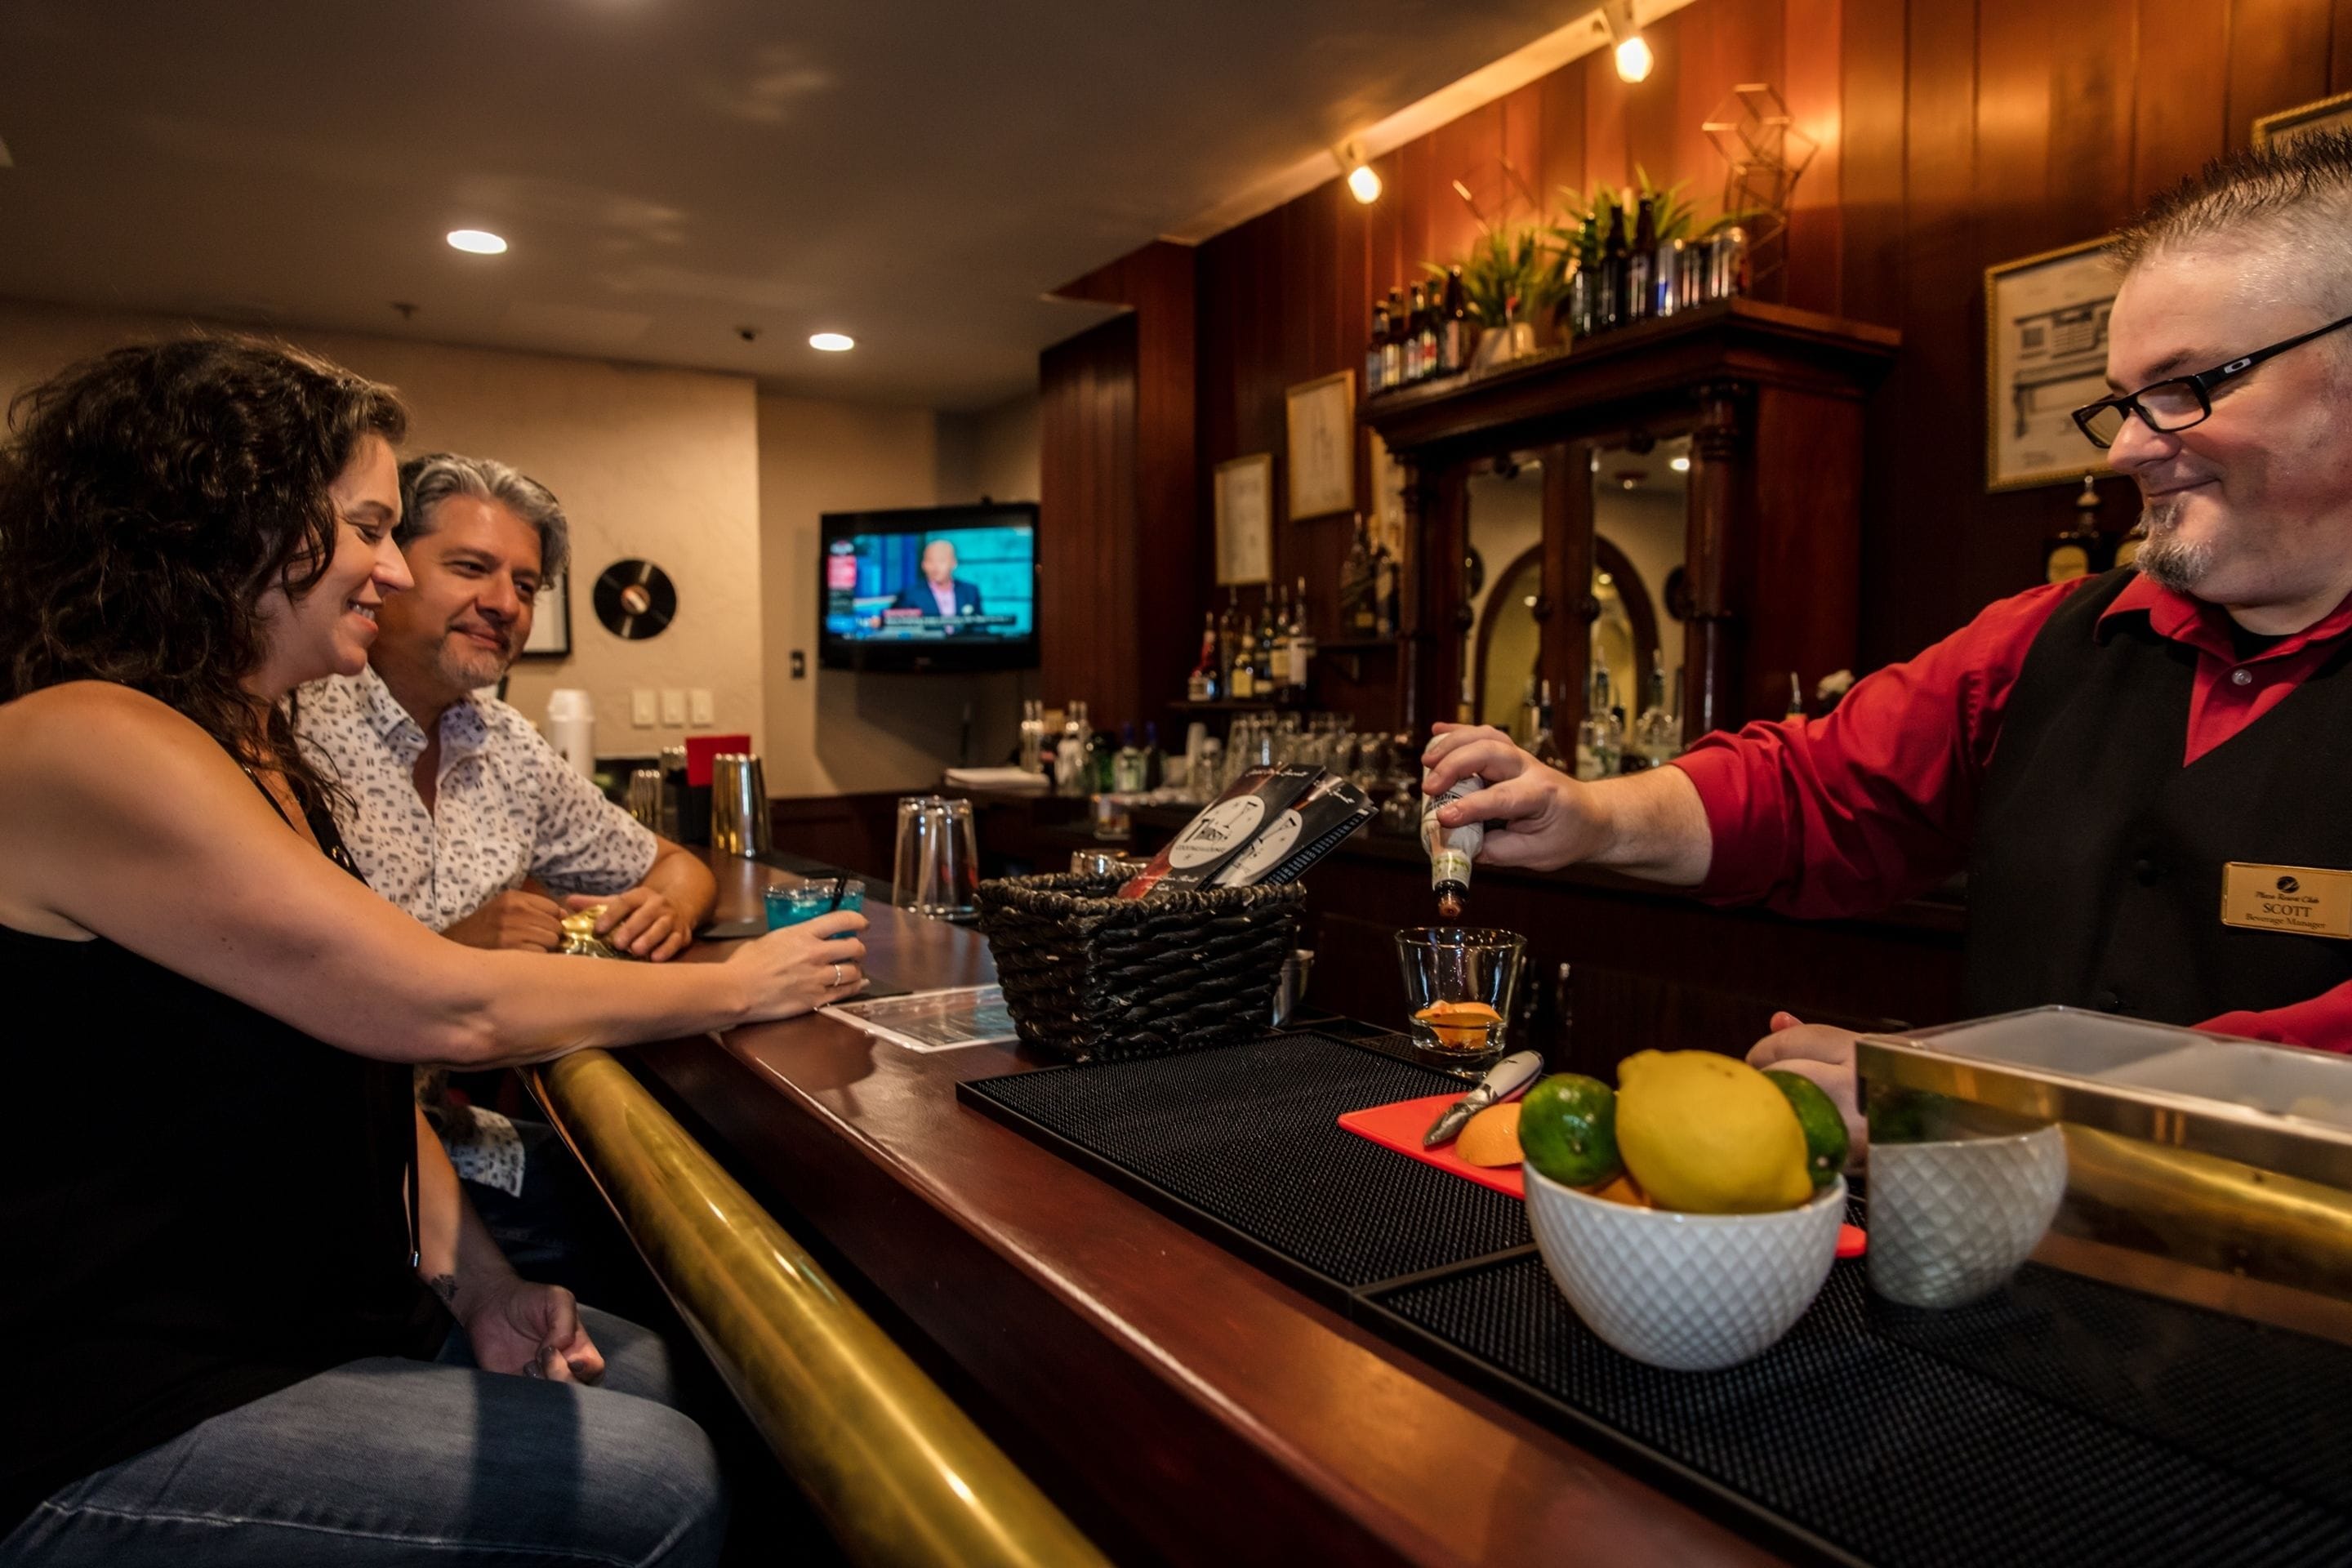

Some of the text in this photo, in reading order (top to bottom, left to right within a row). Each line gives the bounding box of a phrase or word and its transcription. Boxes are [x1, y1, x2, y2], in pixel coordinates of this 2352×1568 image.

[2263, 902, 2312, 916] SCOTT
[2246, 913, 2326, 929] Beverage Manager
